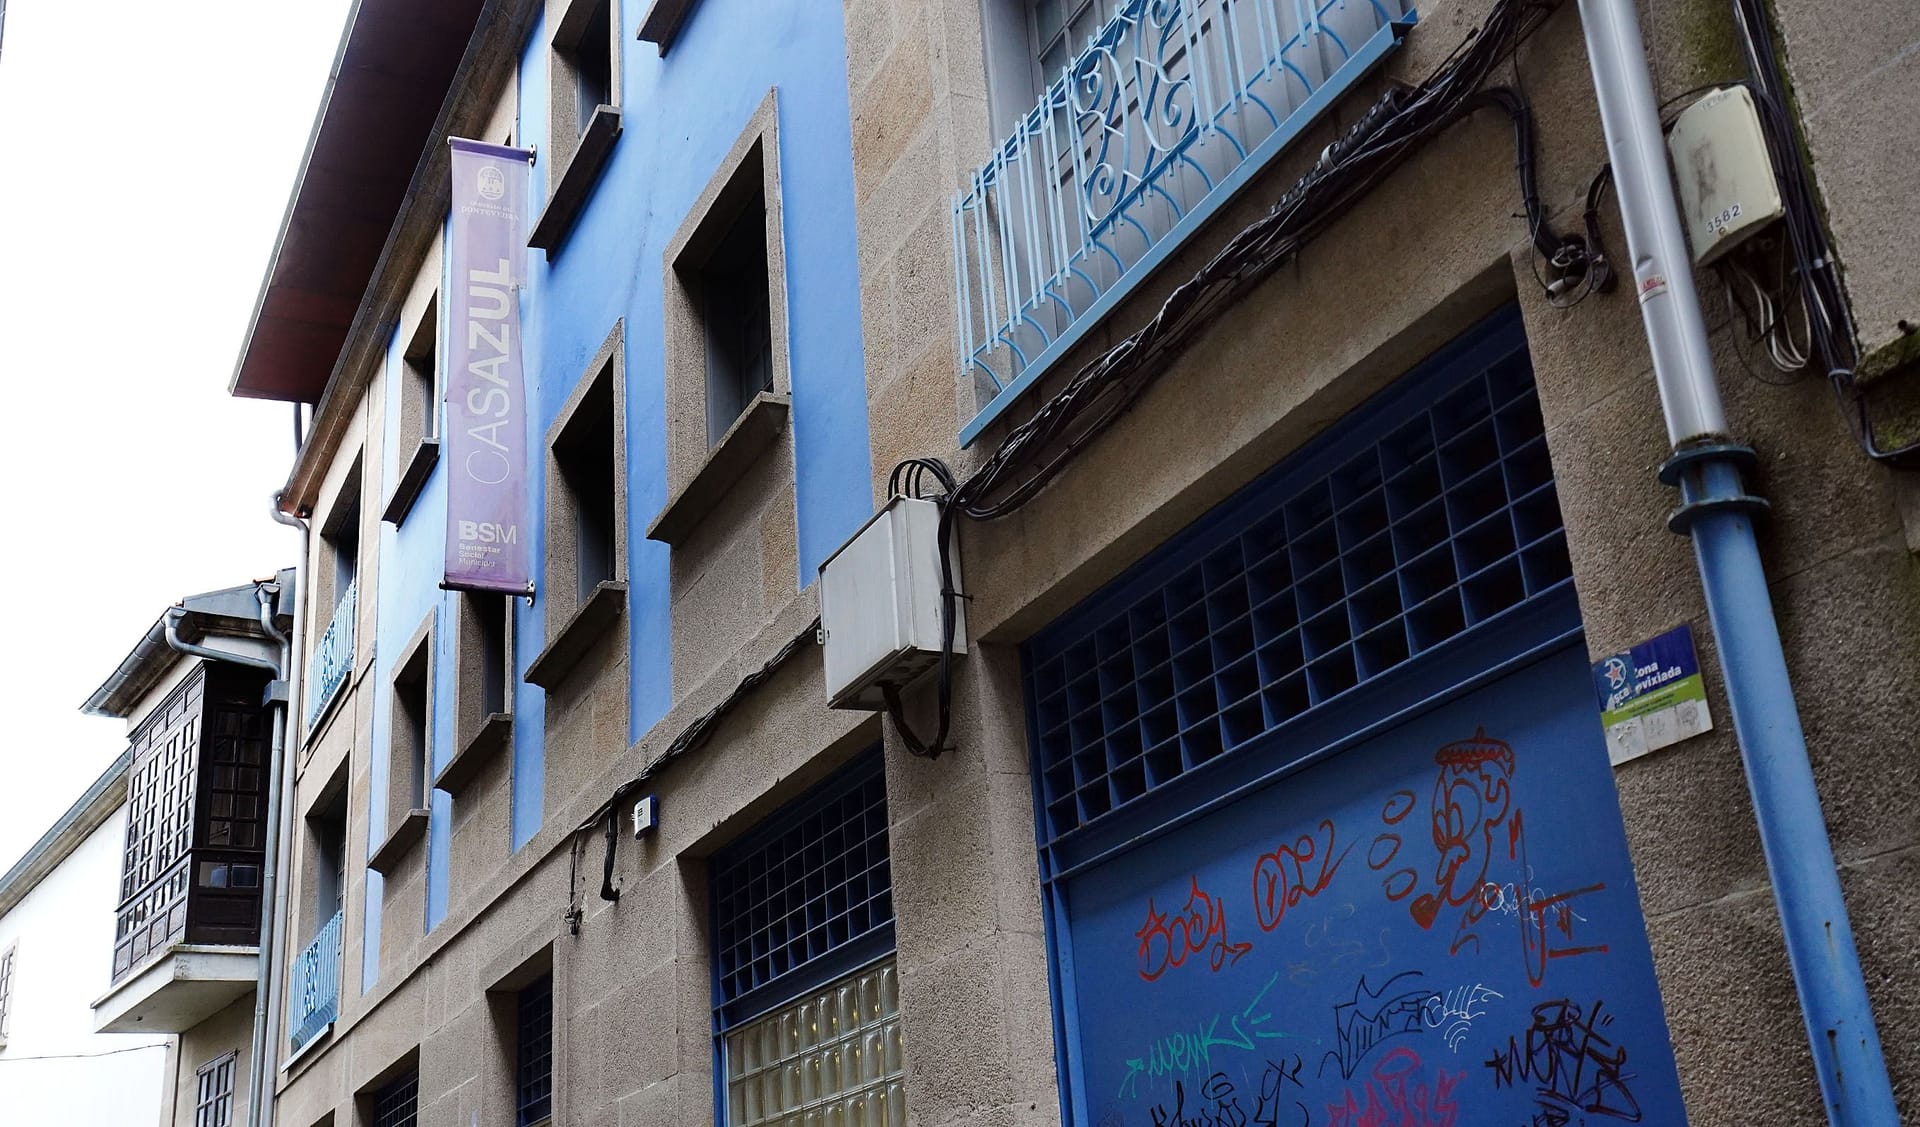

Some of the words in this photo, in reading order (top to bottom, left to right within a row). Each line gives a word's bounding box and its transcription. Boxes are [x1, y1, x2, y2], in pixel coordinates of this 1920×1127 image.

[1707, 204, 1741, 233] 3582
[466, 258, 510, 485] CASAZUL
[459, 519, 517, 545] BSM
[459, 543, 501, 553] Benestar
[459, 550, 484, 559] Social
